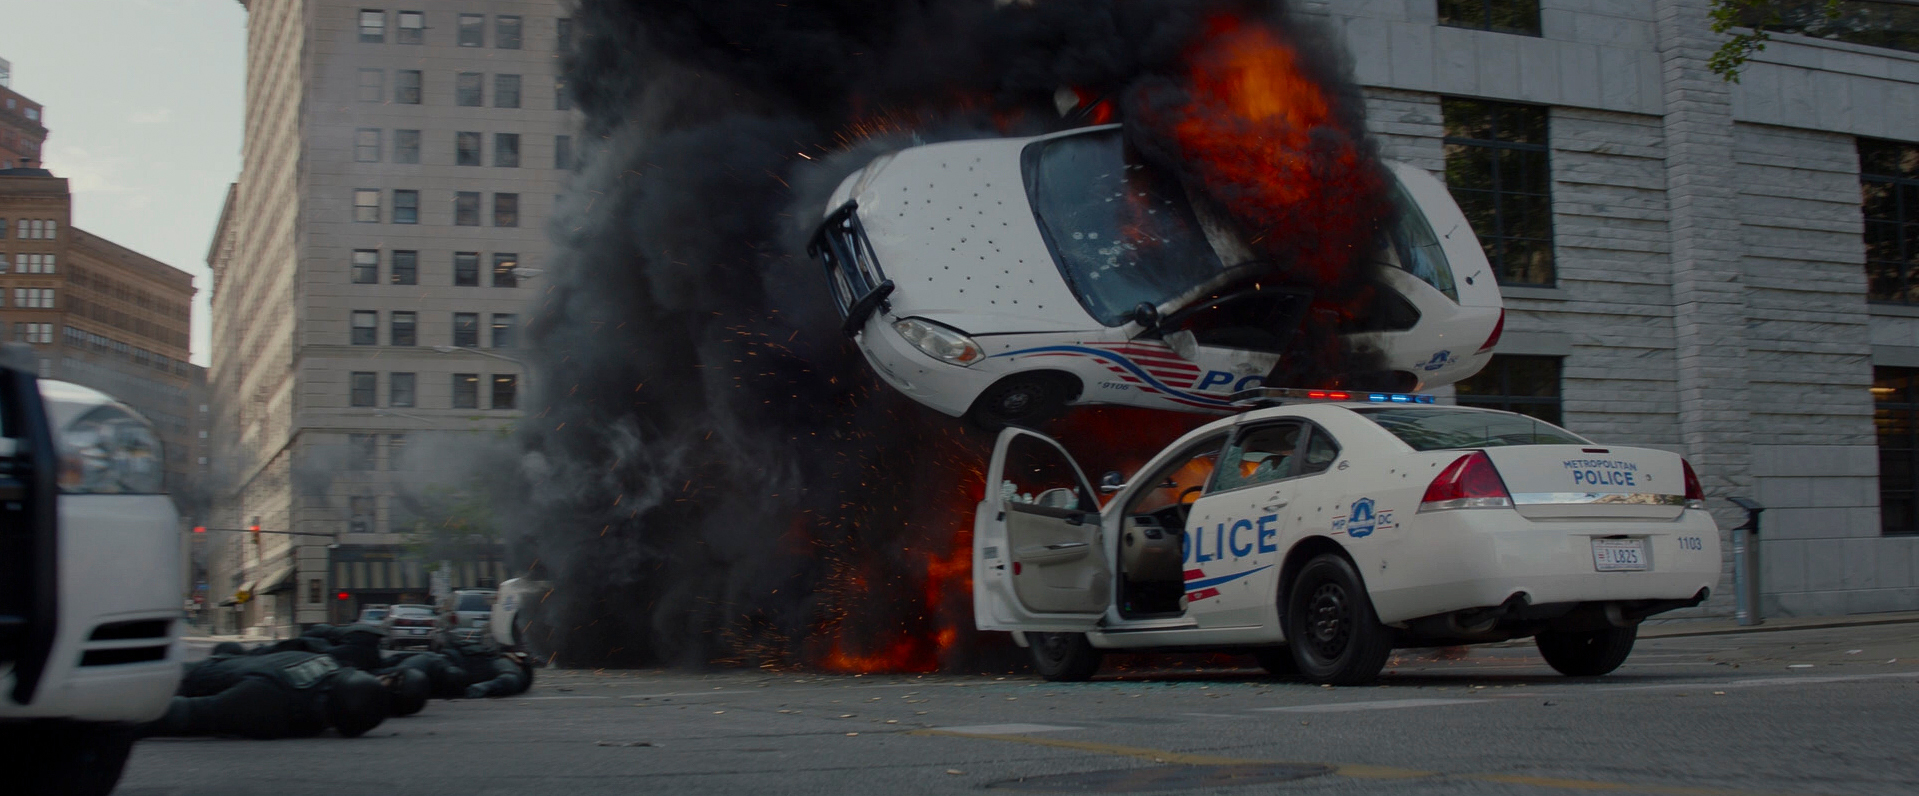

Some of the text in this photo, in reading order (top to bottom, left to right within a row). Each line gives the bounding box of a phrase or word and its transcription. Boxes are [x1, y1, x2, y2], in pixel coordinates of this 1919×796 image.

[1102, 382, 1130, 391] 9106
[1563, 459, 1637, 471] METROPOLITAN
[1573, 470, 1636, 486] POLICE
[1378, 513, 1392, 525] DC
[1677, 536, 1702, 550] 1103
